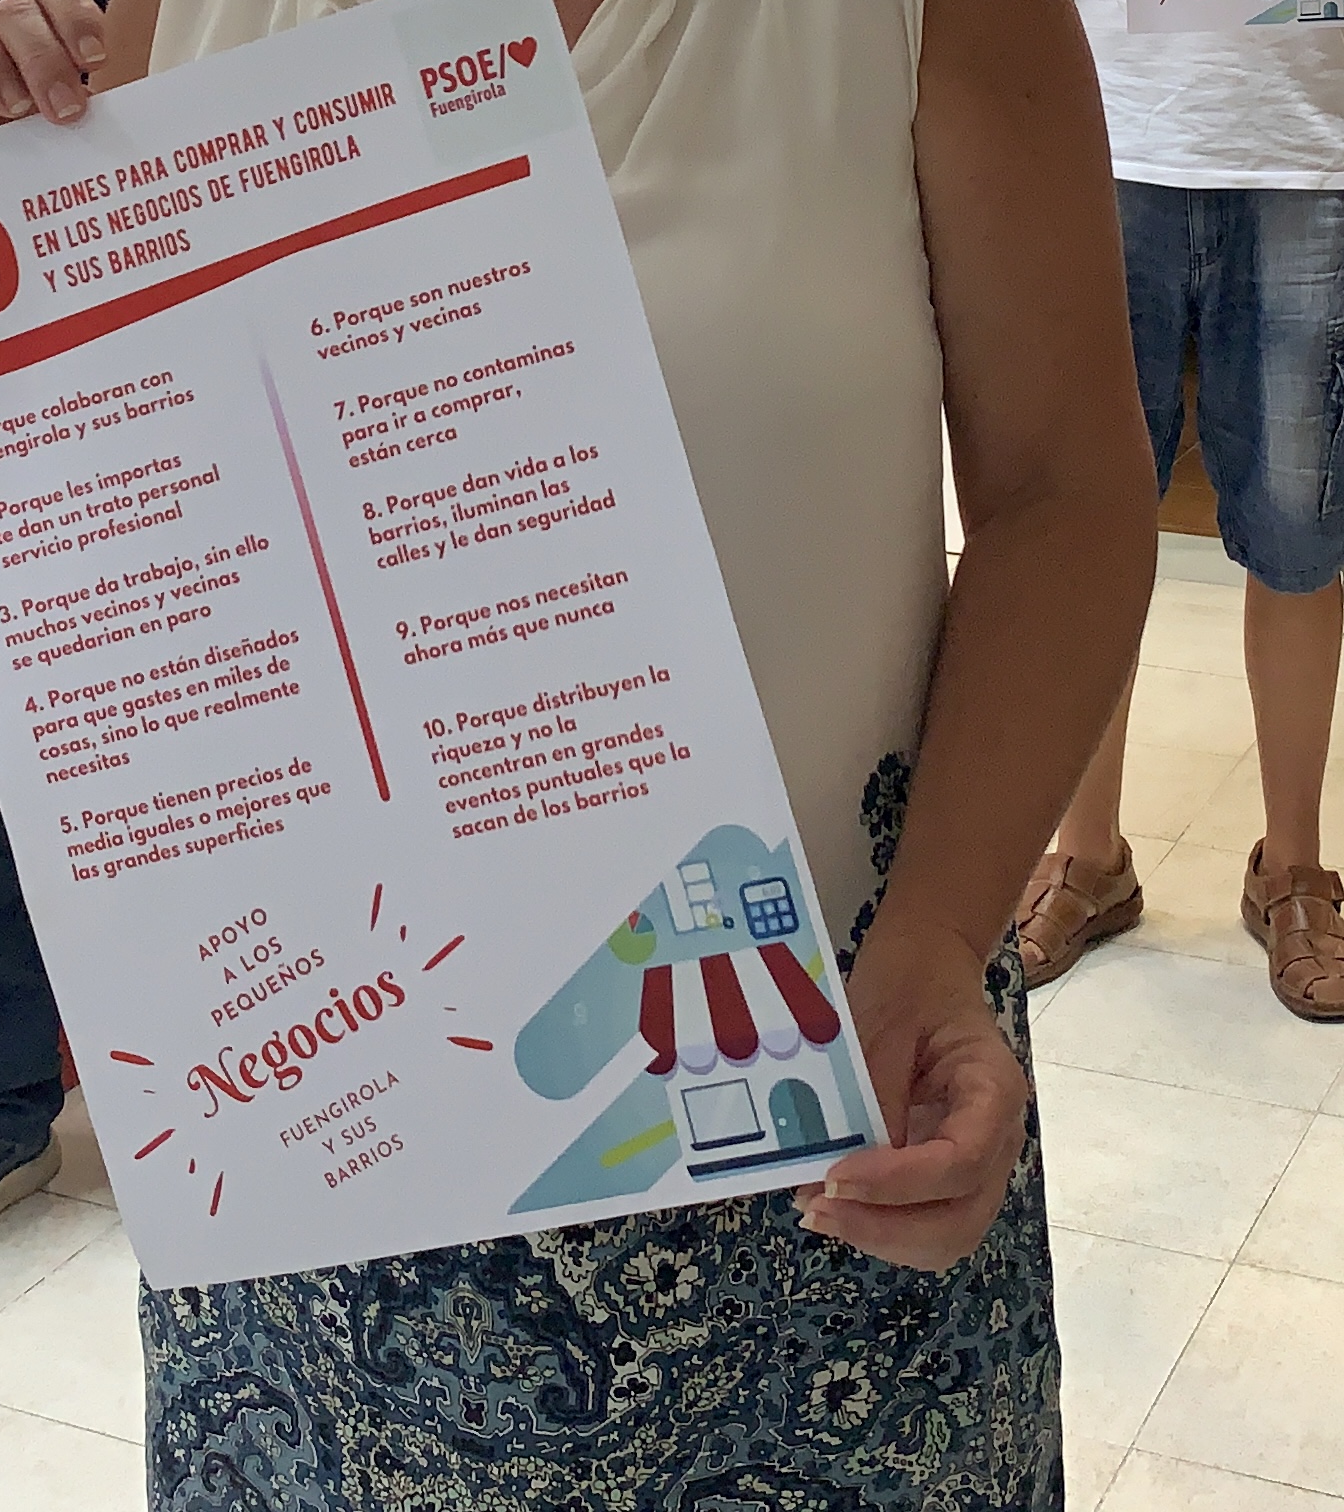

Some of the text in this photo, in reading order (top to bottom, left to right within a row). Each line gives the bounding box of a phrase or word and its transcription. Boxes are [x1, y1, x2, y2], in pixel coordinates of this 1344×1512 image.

[429, 82, 507, 119] Fuengirola
[21, 82, 397, 222] RAZONES PARA COMPRAR Y CONSUMIR
[32, 134, 361, 259] EN LOS NEGOCIOS DE FUENGIROLA
[42, 228, 191, 293] Y SUS BARRIOS
[41, 382, 137, 420] colaboran
[140, 371, 174, 390] con
[73, 422, 86, 441] y
[91, 411, 122, 431] sus
[123, 389, 195, 420] barrios
[395, 570, 629, 641] 9. Porque nos necesitan
[403, 601, 615, 665] ahora más que nunca
[198, 908, 267, 962] APOYO
[223, 936, 283, 985] A LOS
[210, 948, 325, 1028] PEQUEÑOS
[186, 970, 406, 1119] Negocios
[279, 1070, 400, 1149] FUENGIROLA
[321, 1115, 377, 1155] Y SUS
[323, 1133, 404, 1189] BARRIOS
